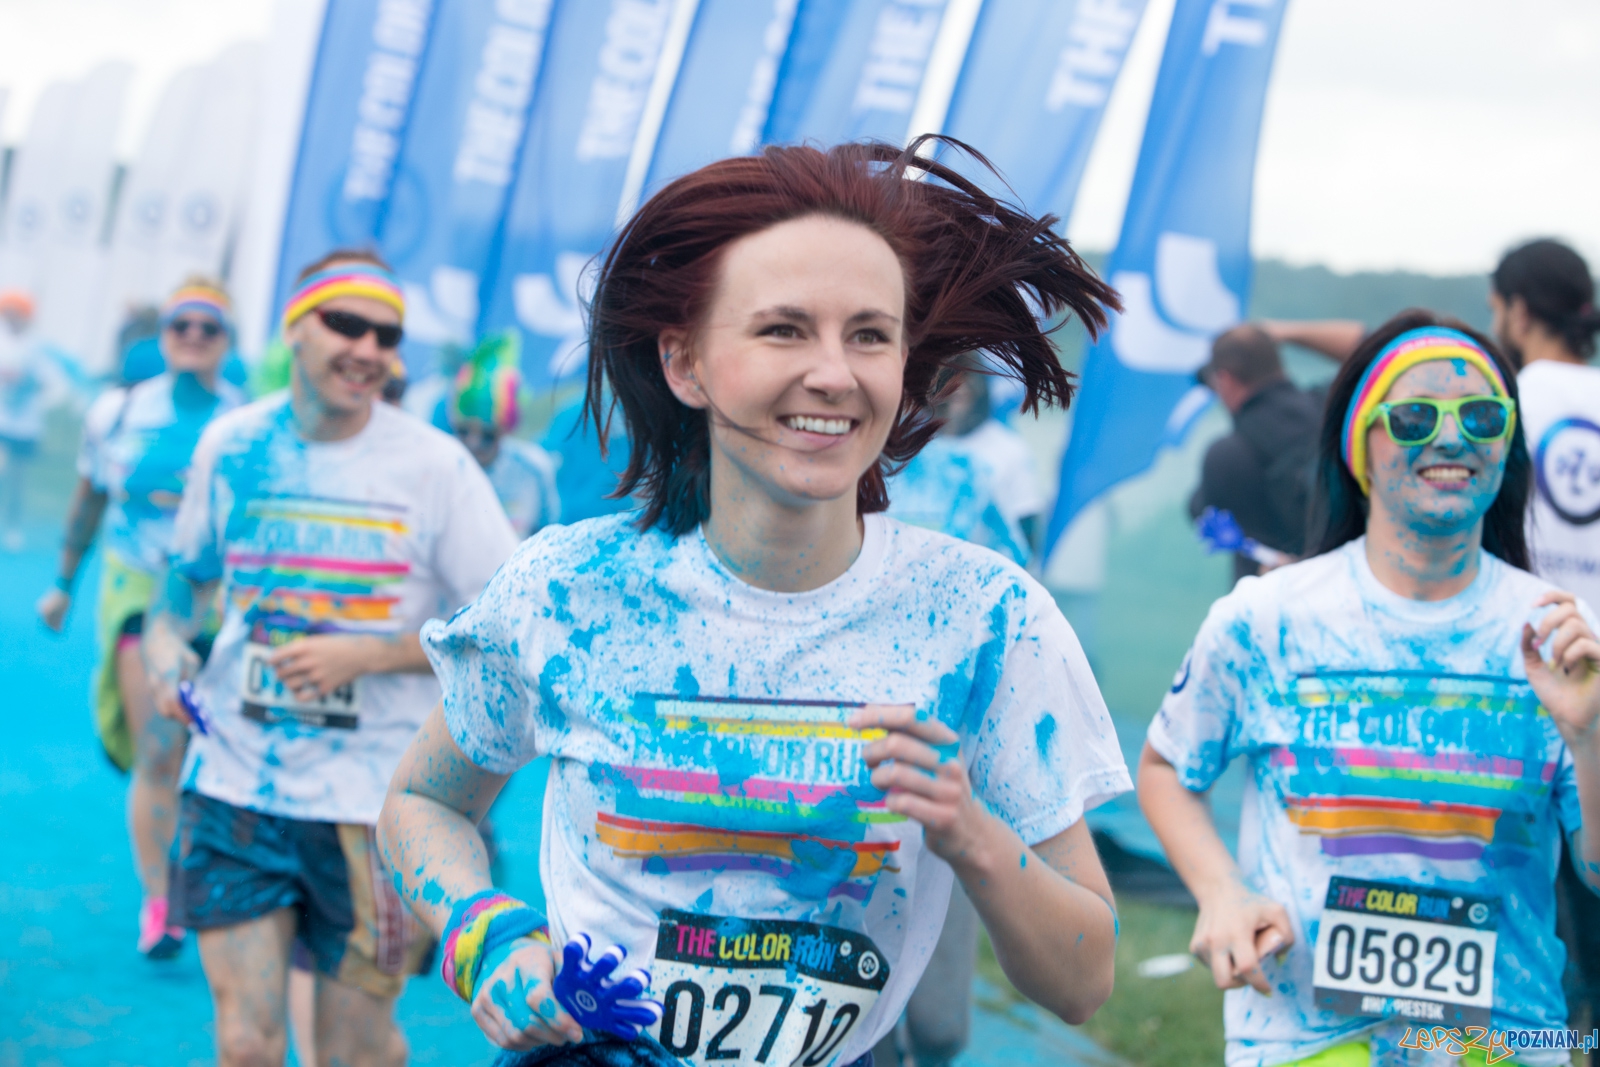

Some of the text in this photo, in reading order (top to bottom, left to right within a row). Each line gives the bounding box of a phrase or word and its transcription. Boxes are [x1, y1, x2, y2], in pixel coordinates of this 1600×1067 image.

[1338, 886, 1367, 909] THE
[1366, 888, 1419, 916] COLOR
[1418, 895, 1450, 919] RUN
[676, 924, 837, 973] THE COLOR RUN
[1327, 923, 1483, 997] 05829
[659, 979, 861, 1067] 02710
